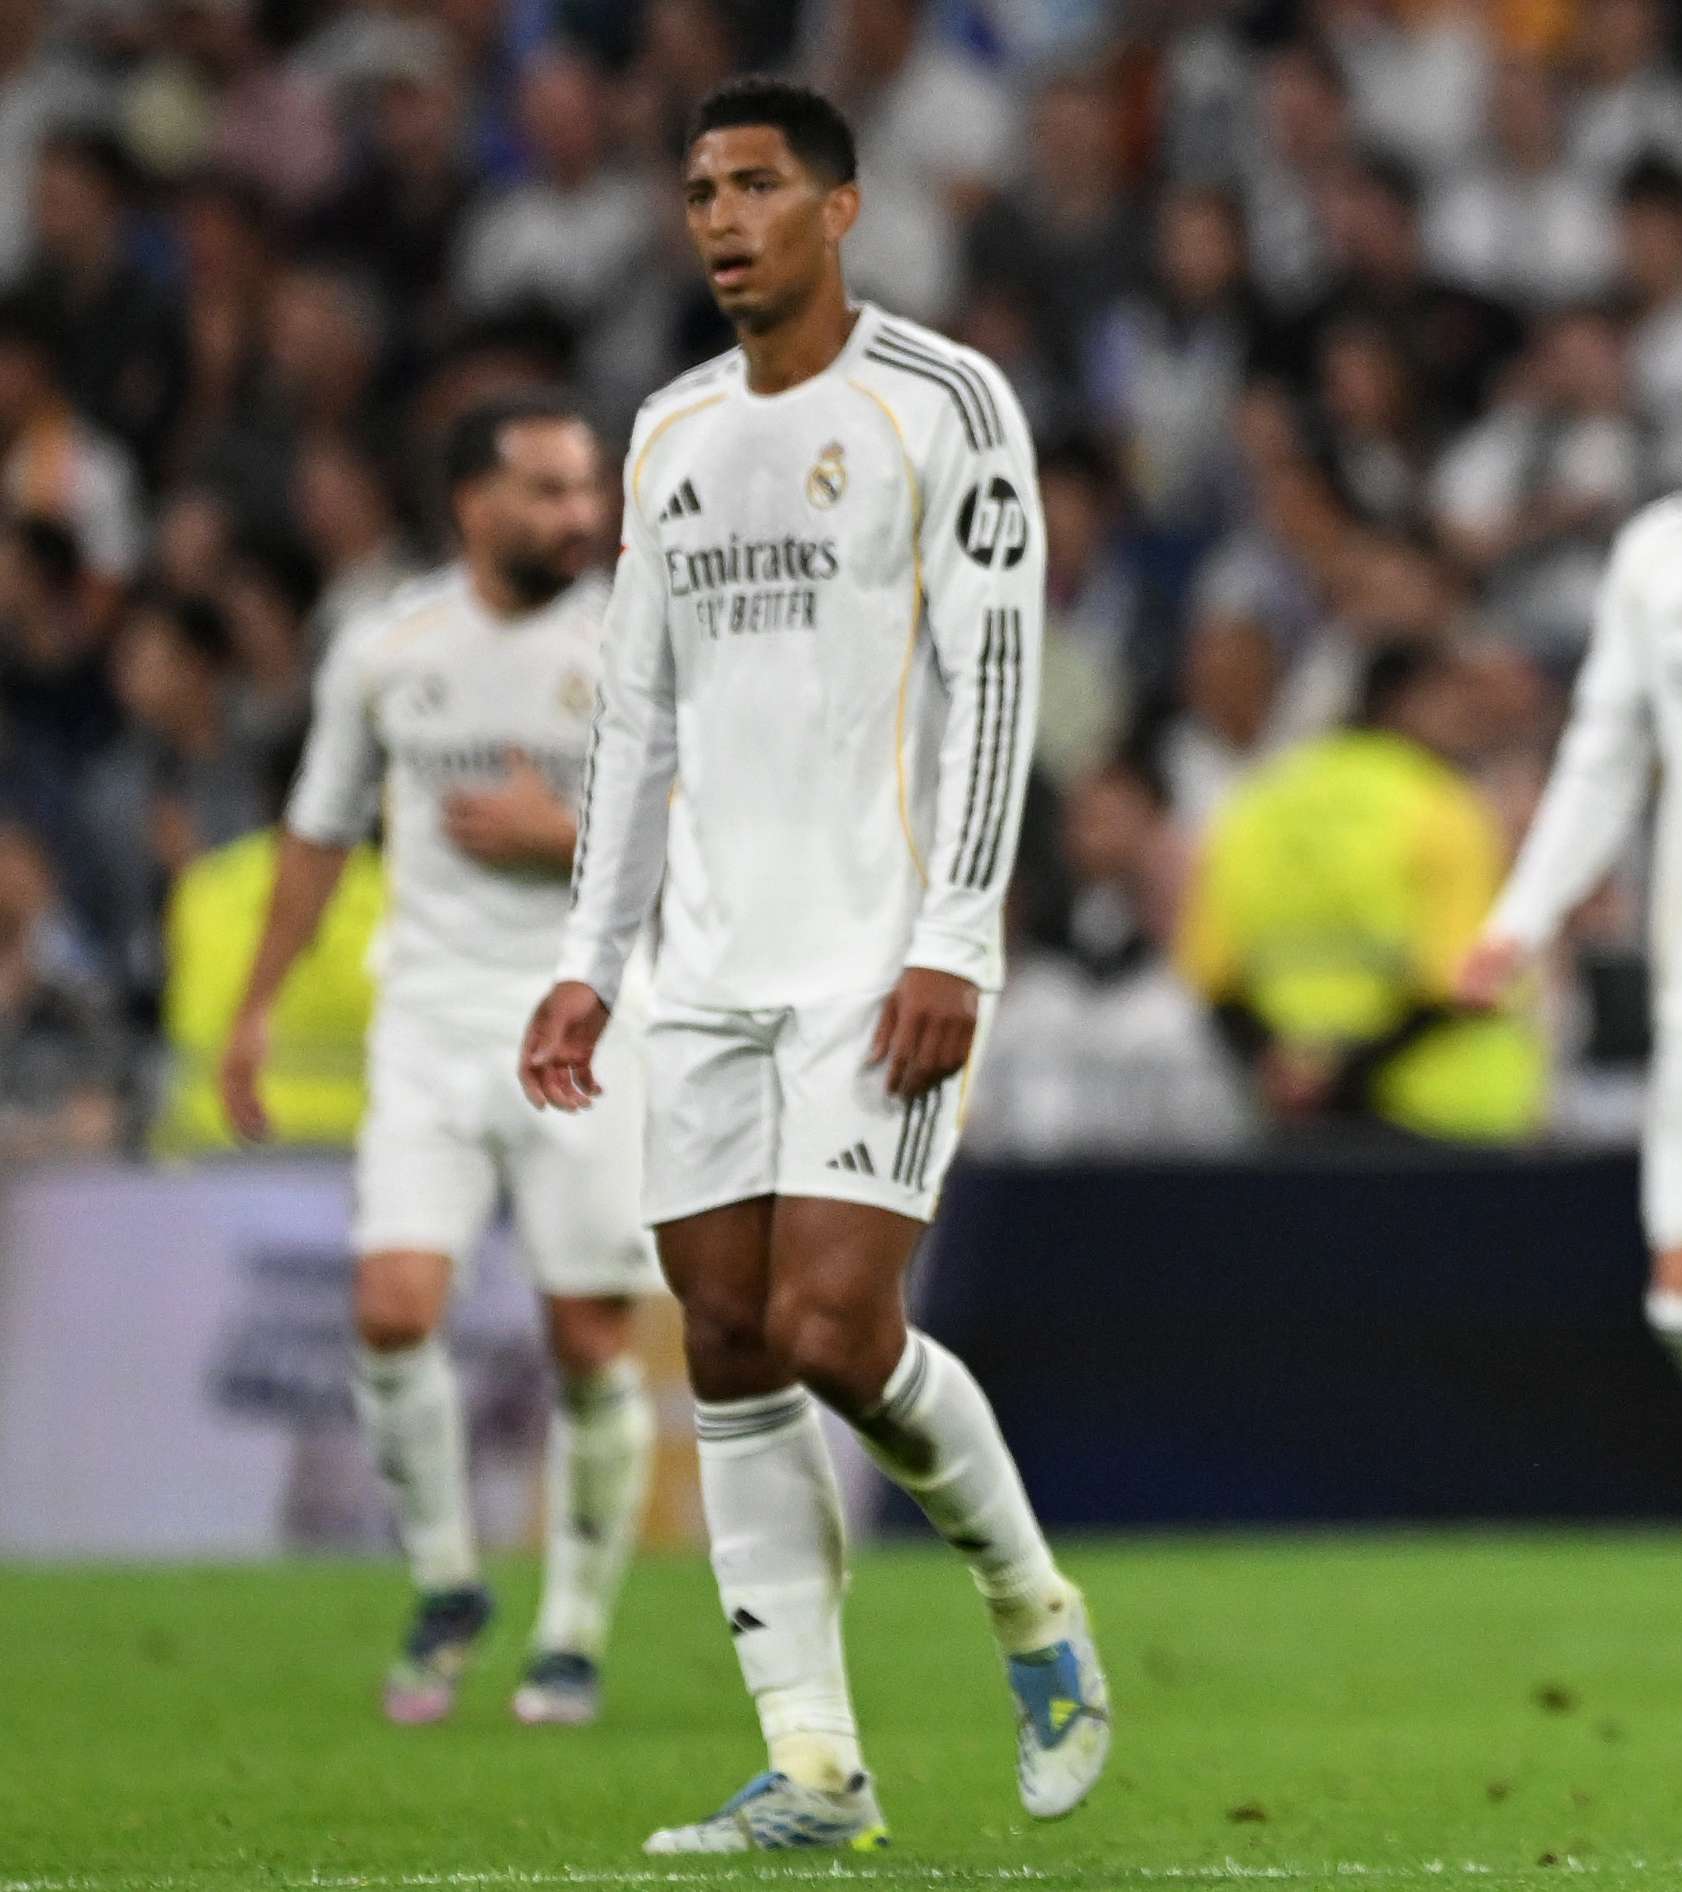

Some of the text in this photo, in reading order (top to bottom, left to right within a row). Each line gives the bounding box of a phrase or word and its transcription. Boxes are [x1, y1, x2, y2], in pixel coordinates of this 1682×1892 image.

[962, 476, 1026, 569] hp
[665, 532, 839, 596] Emirates
[729, 591, 816, 634] BETTER
